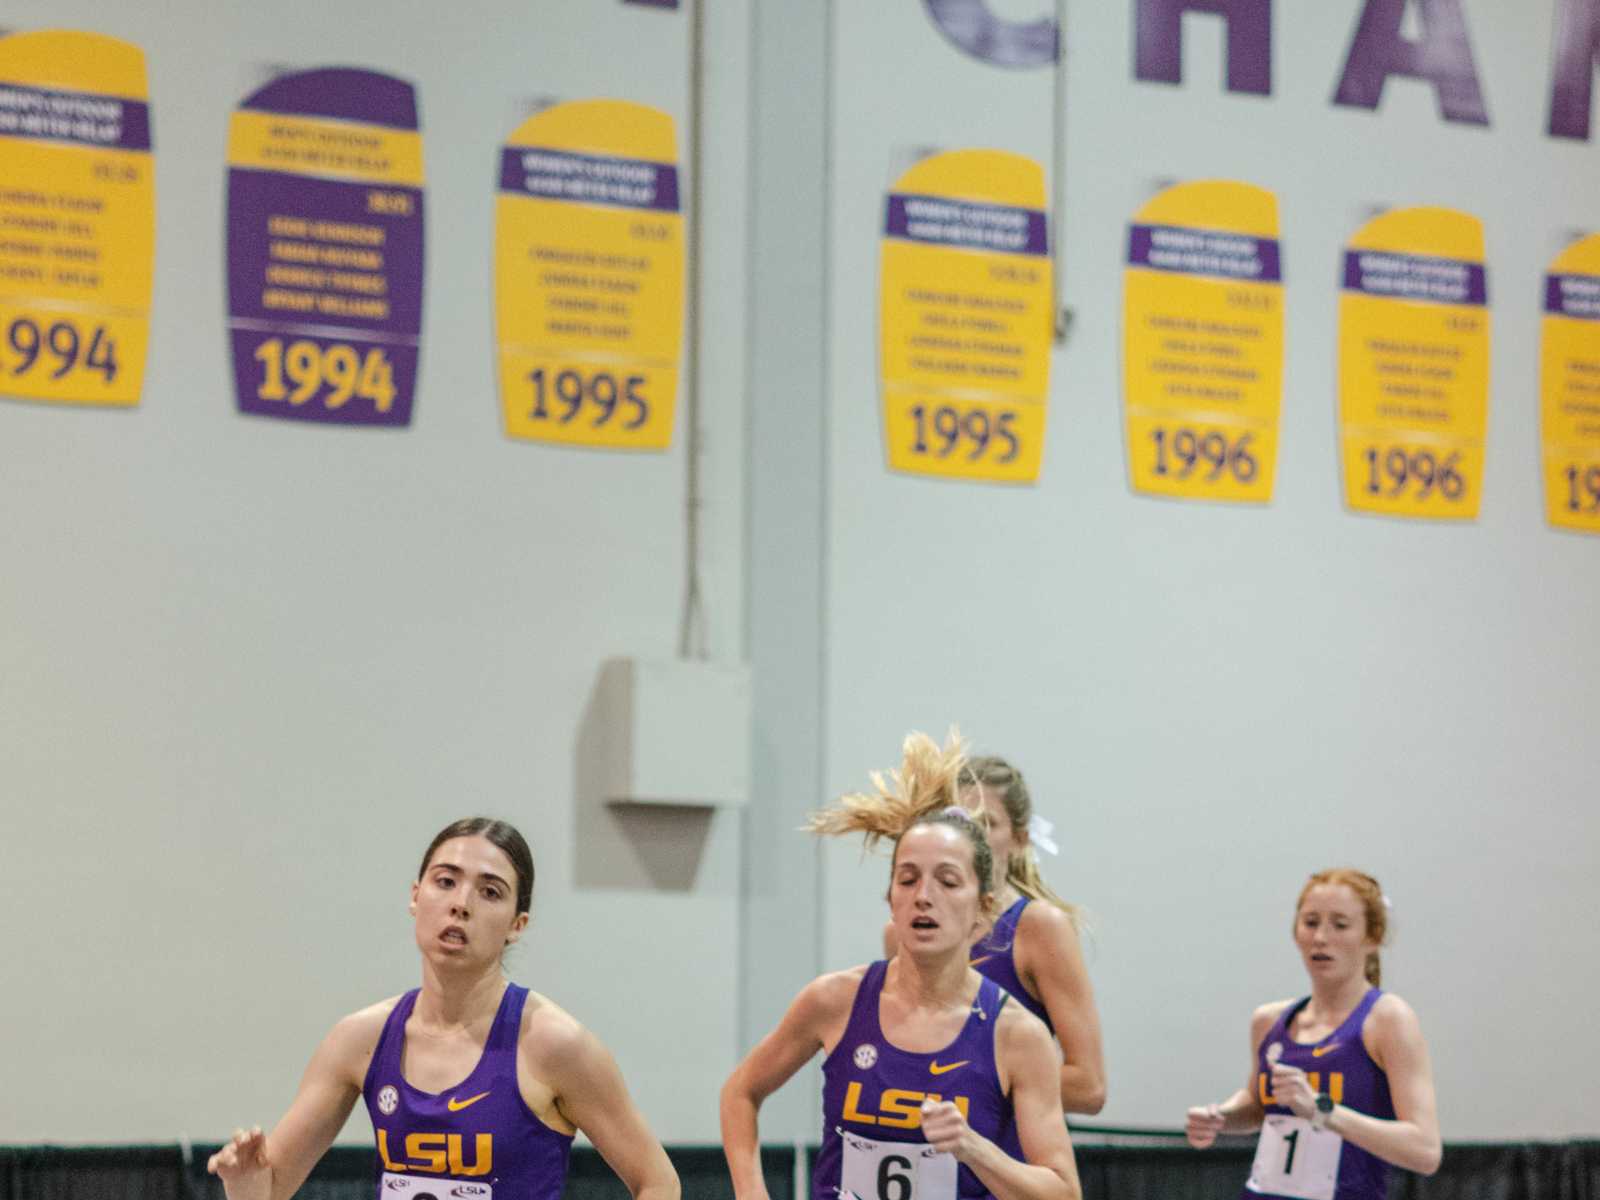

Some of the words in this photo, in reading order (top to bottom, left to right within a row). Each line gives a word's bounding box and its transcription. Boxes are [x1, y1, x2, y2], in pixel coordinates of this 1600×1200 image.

[0, 316, 118, 382] 994
[254, 338, 398, 412] 1994
[525, 367, 650, 431] 1995
[908, 404, 1020, 465] 1995
[1149, 427, 1259, 484] 1996
[1364, 446, 1467, 502] 1996
[1258, 1072, 1344, 1105] LU
[376, 1127, 493, 1177] LSU
[1283, 1129, 1299, 1175] 1
